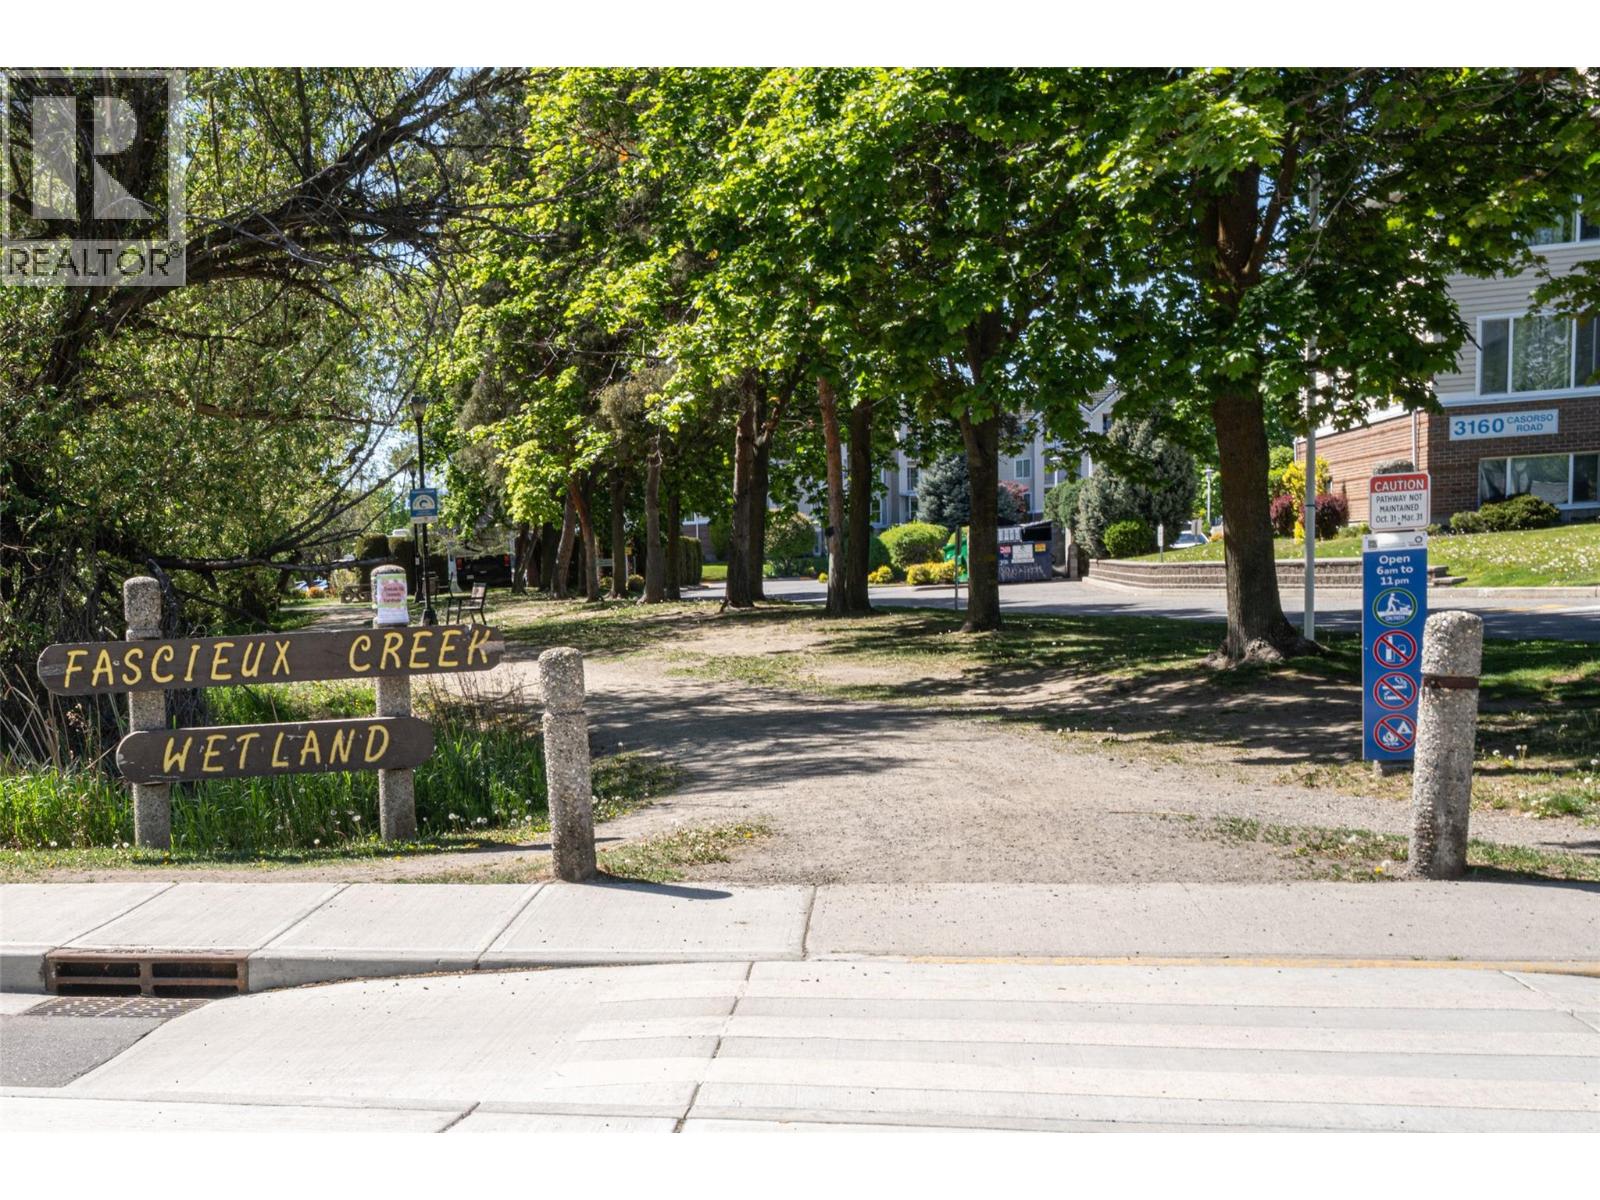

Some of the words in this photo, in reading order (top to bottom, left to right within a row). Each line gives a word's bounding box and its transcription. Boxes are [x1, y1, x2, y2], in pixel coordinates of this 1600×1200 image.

[1506, 413, 1554, 424] CASORSO
[1454, 418, 1504, 436] 3160
[1516, 423, 1543, 433] ROAD
[1374, 479, 1424, 492] CAUTION
[1376, 494, 1407, 503] PATHWAY
[1409, 493, 1423, 501] NOT
[1379, 503, 1419, 512] MAINTAINED
[1375, 515, 1388, 523] Oct.
[1379, 555, 1411, 566] Open
[1376, 566, 1398, 575] 6am
[1400, 565, 1414, 573] to
[349, 629, 491, 672] CREEK
[64, 640, 291, 689] FASCIEUX
[163, 724, 390, 773] WETLAND
